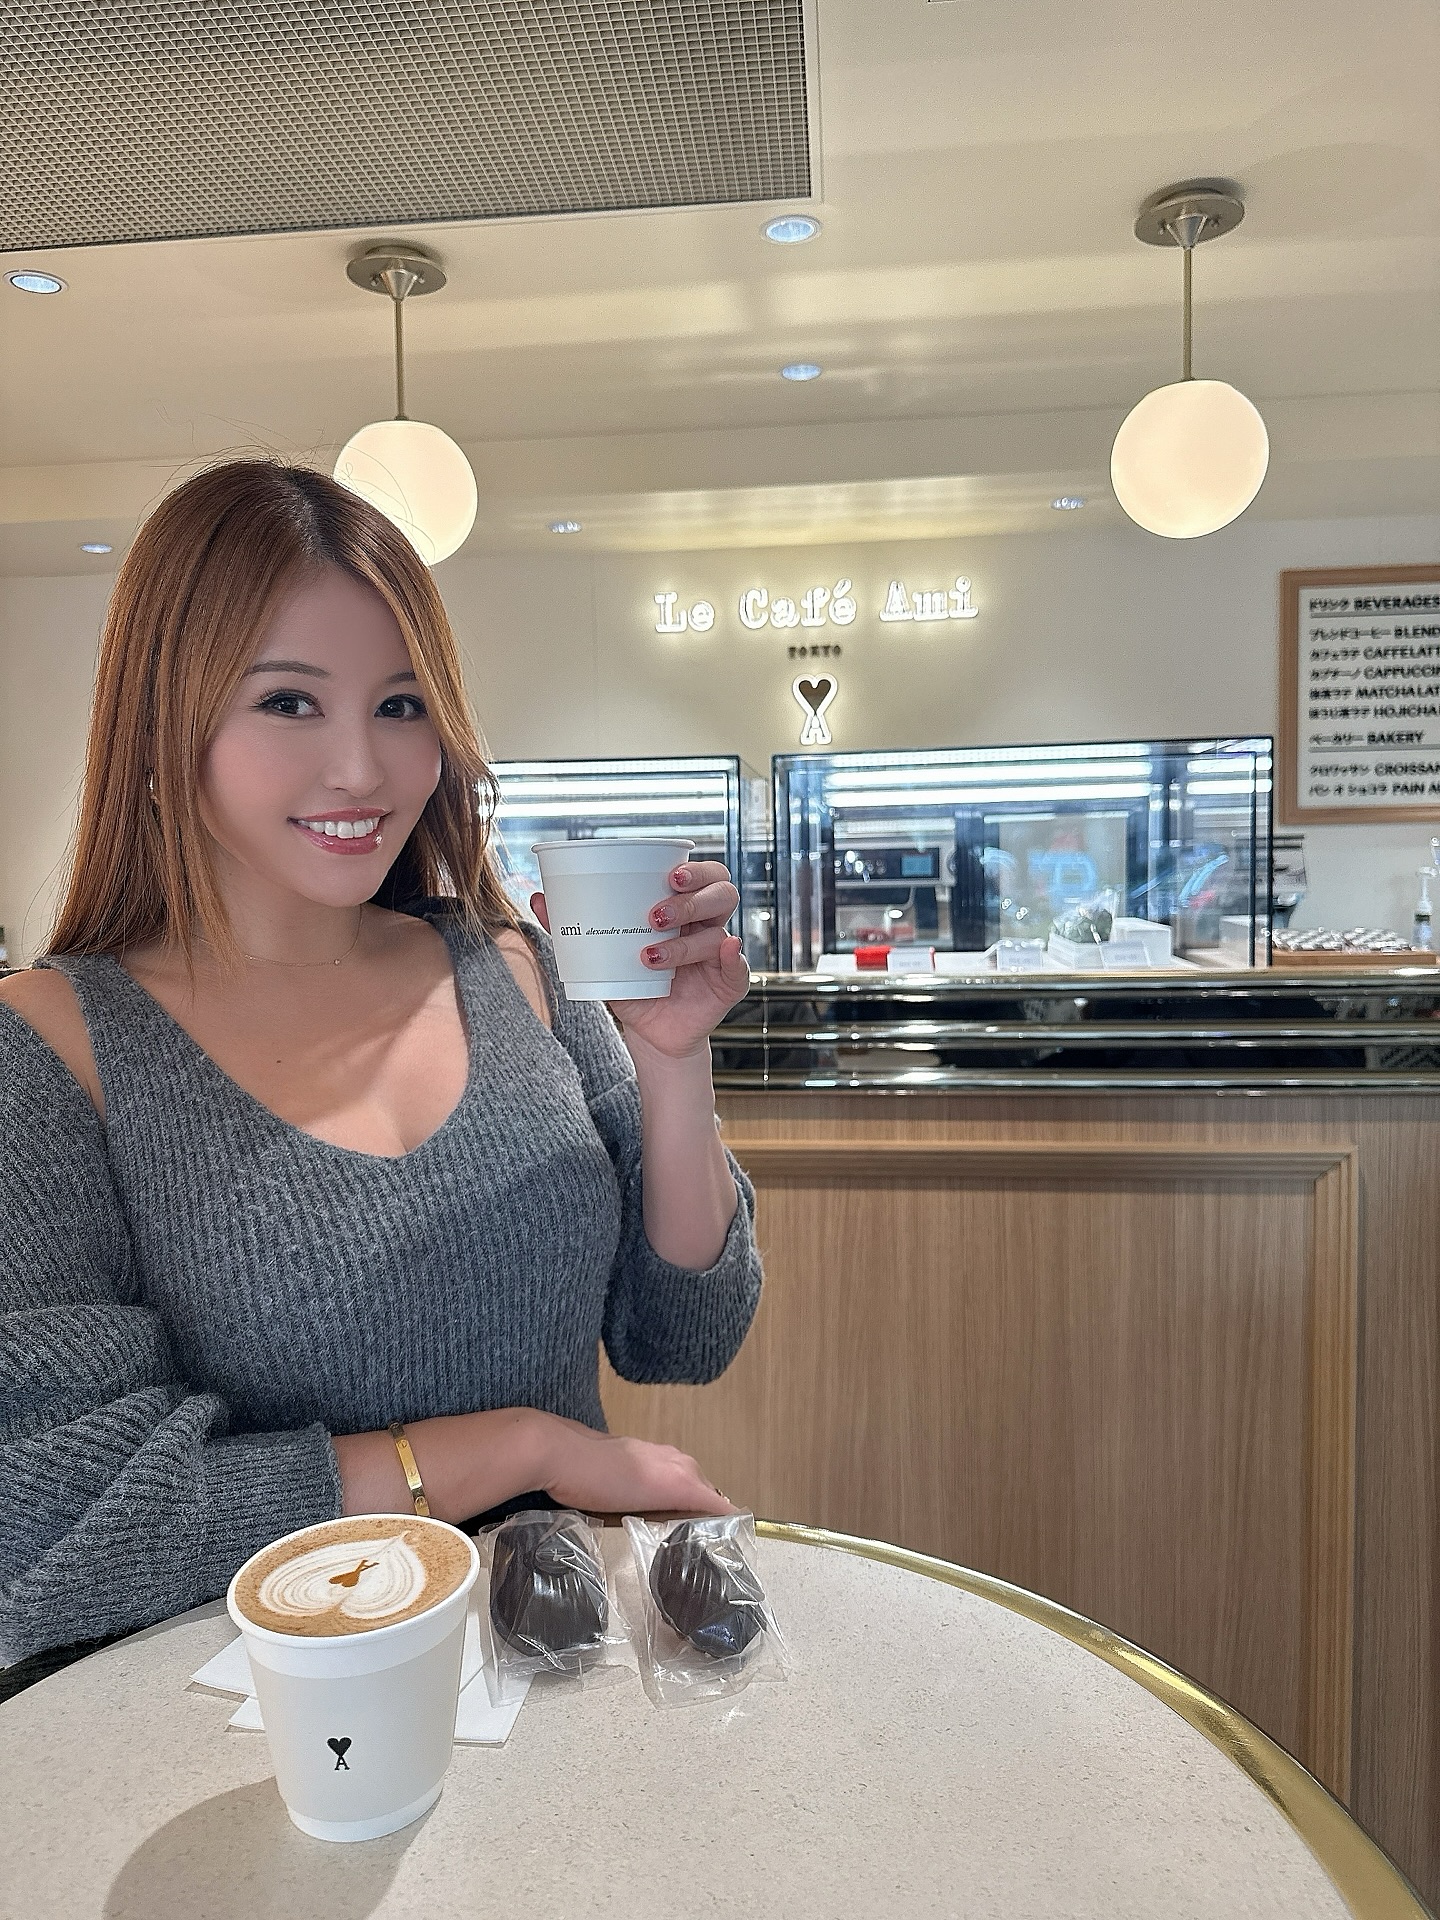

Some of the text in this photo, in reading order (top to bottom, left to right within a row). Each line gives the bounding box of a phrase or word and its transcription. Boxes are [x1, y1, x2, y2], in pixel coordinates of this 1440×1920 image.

[654, 576, 979, 633] Le Café Ami
[1354, 595, 1440, 610] BEVERAGES
[1394, 625, 1440, 639] BLEND
[1367, 729, 1424, 744] BAKERY
[1391, 780, 1425, 796] PAIN
[560, 923, 582, 936] ami
[585, 927, 620, 936] alexandre
